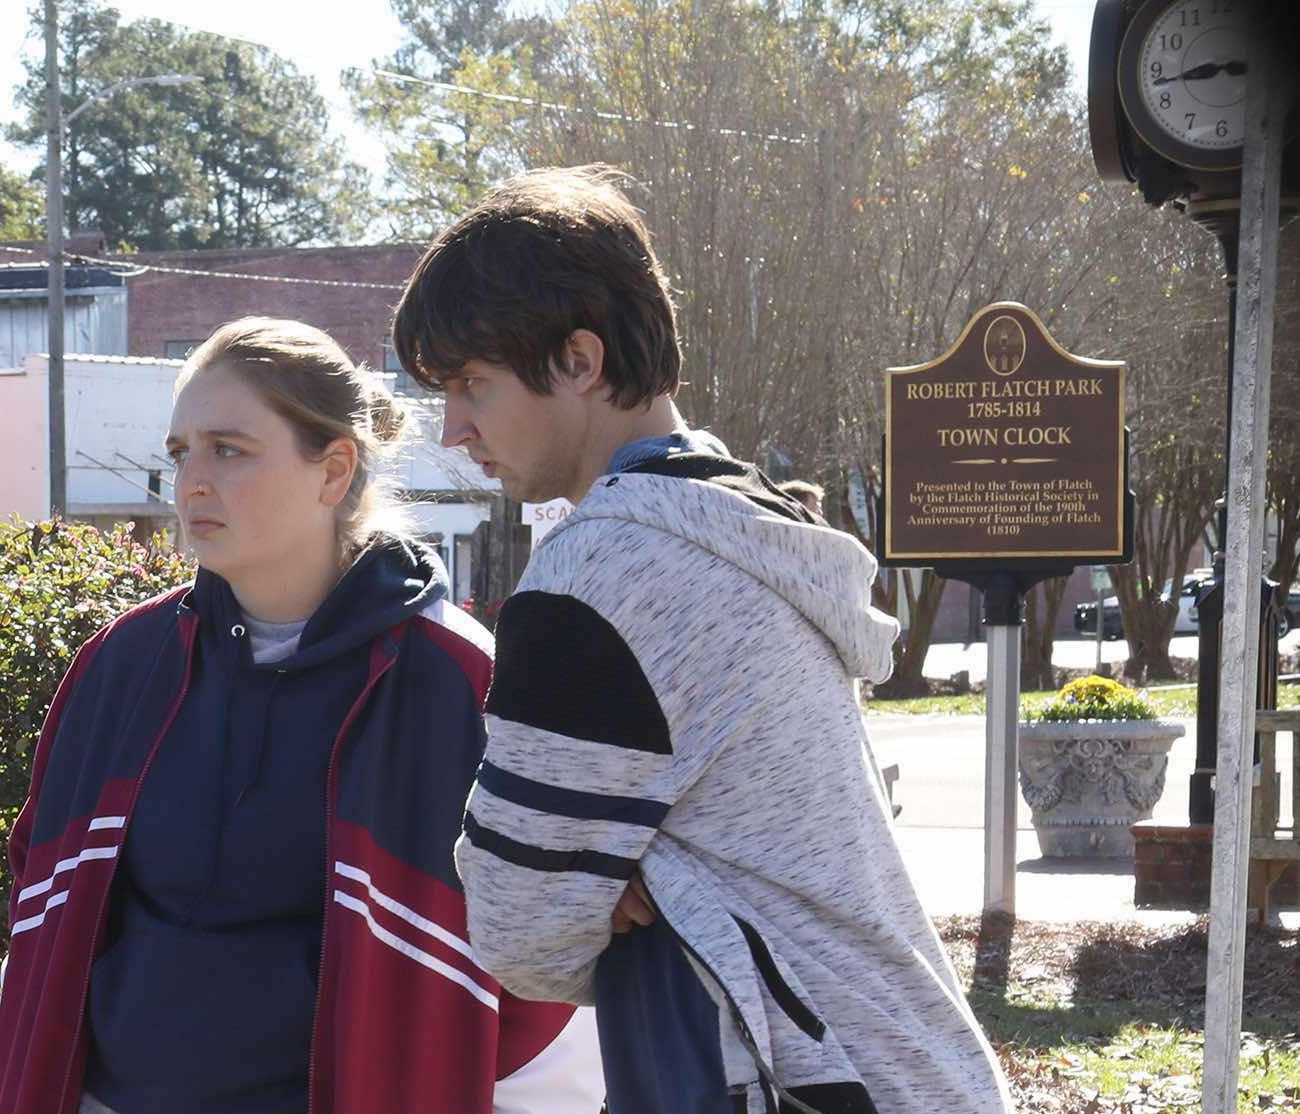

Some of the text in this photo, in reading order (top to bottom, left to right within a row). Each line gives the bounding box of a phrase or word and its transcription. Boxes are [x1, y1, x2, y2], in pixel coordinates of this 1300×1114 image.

[1180, 10, 1200, 27] 11
[1160, 33, 1183, 51] 10
[1151, 62, 1162, 79] 9
[1159, 92, 1171, 110] 8
[1184, 113, 1196, 131] 7
[1216, 120, 1228, 138] 6
[907, 379, 1103, 400] ROBERT FLATCH PARK
[967, 401, 1041, 418] 1785-1814
[937, 426, 1072, 447] TOWN CLOCK
[916, 479, 1092, 493] Presented to the Town of Flatch
[909, 490, 1099, 505] by the Flatch Historical Society in
[922, 500, 1086, 514] Commemoration of the 190th
[907, 511, 1101, 527] Anniversary of Founding of Flatch
